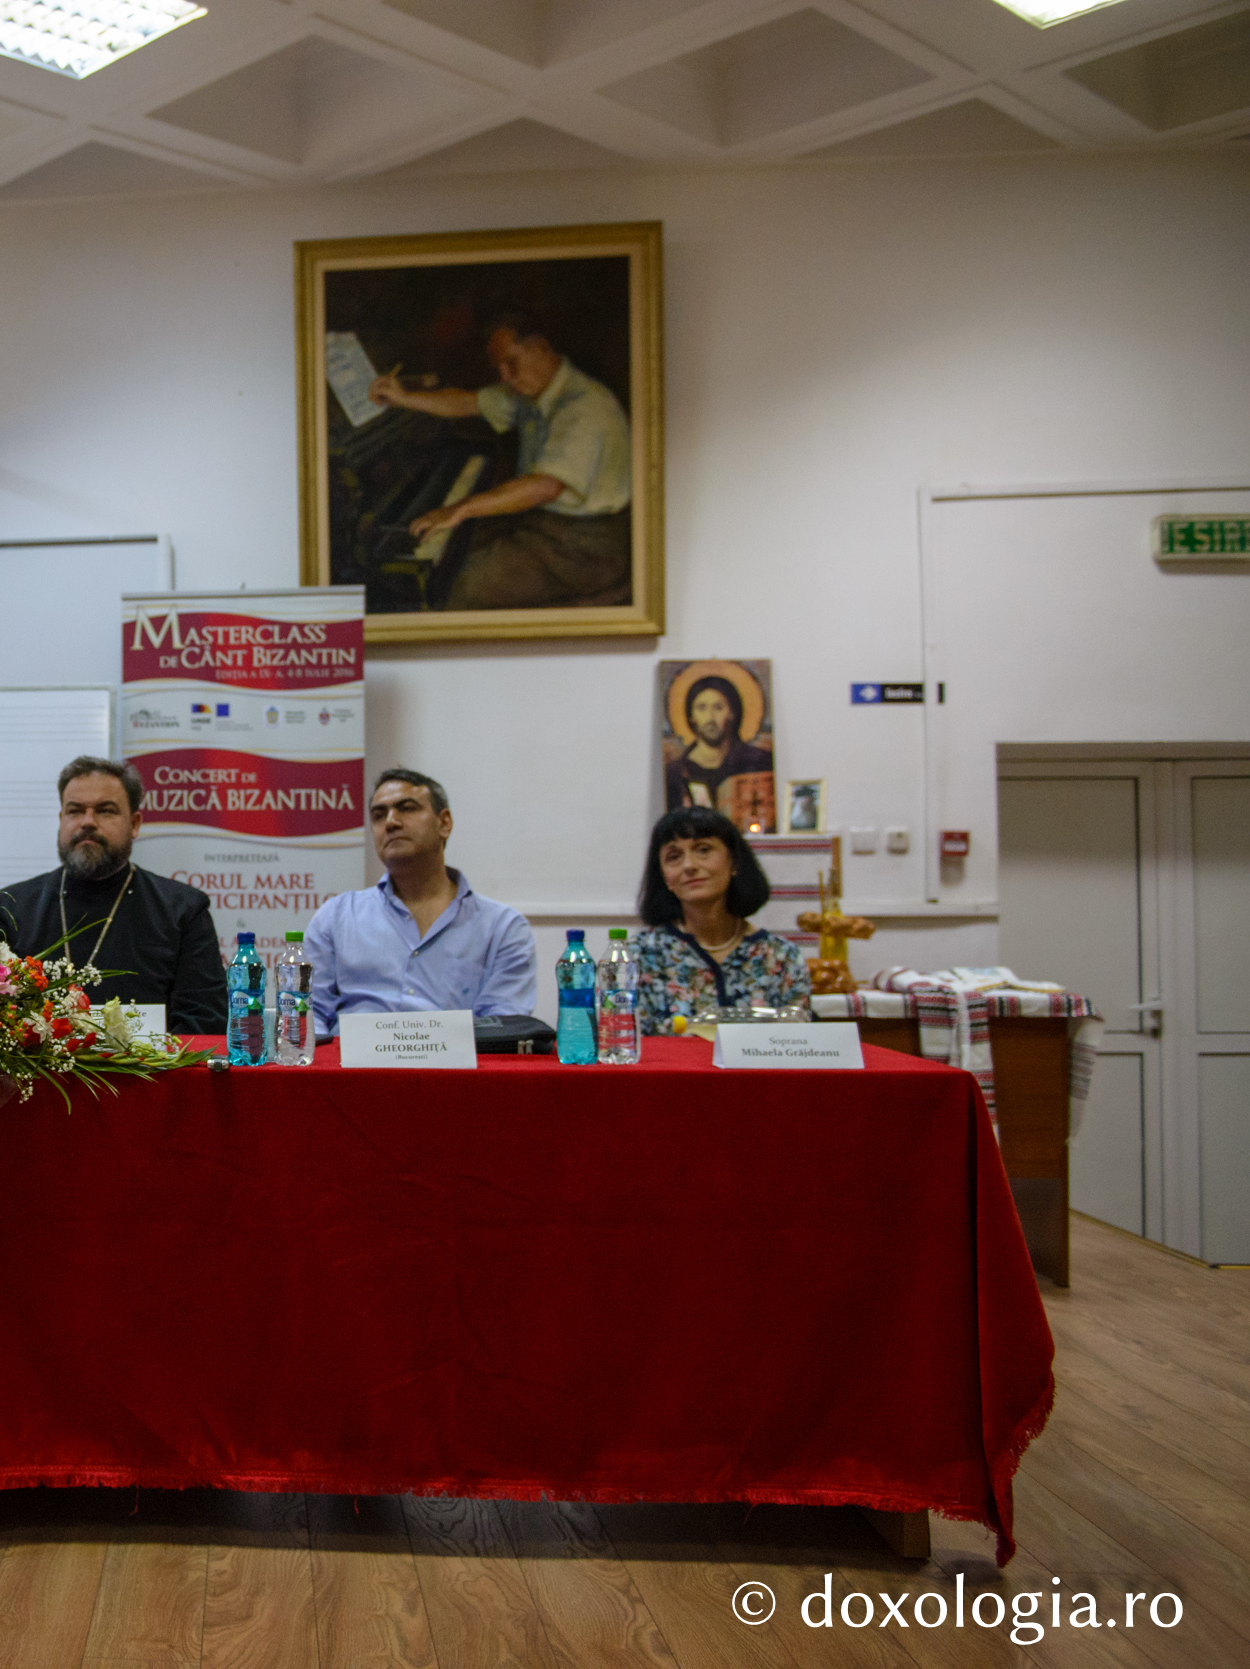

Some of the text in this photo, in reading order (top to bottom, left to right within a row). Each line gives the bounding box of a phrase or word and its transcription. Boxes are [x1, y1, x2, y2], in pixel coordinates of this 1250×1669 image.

[130, 604, 327, 651] MASTERCLASS
[159, 644, 356, 669] DE CÂNT BIZANTIN
[154, 765, 257, 785] CONCERT DE
[227, 784, 355, 811] BIZANTINĂ
[254, 873, 314, 889] MARE
[375, 1019, 444, 1029] Conf. Univ. Dr.
[393, 1032, 430, 1041] Nicolae
[768, 1036, 808, 1046] Soprana
[375, 1042, 448, 1053] GHEORGHIȚĂ
[741, 1048, 783, 1057] Mihaela
